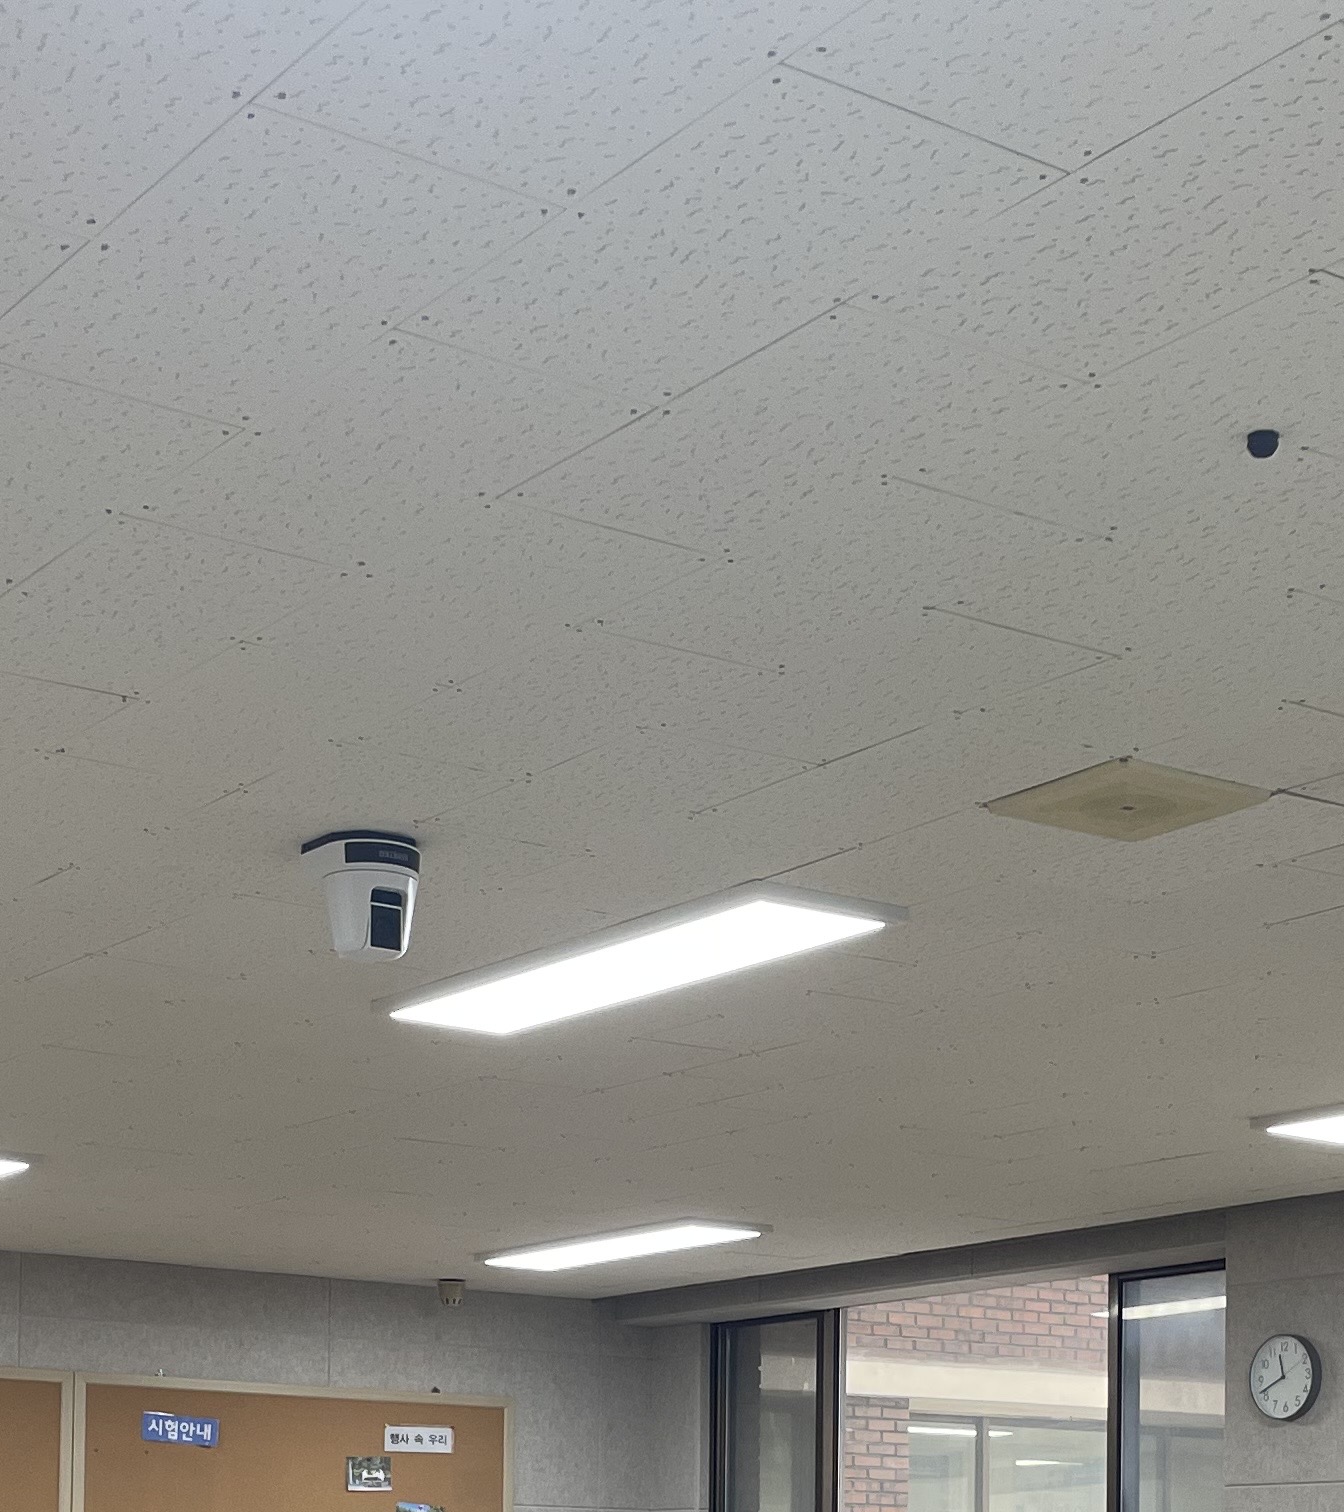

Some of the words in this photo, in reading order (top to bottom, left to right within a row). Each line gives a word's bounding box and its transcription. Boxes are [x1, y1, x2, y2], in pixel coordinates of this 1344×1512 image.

[1269, 1347, 1276, 1357] 11
[1281, 1341, 1289, 1352] 12
[1294, 1343, 1298, 1354] 1
[1302, 1353, 1308, 1364] 2
[1261, 1360, 1269, 1369] 10
[1305, 1368, 1311, 1380] 3
[1258, 1375, 1264, 1386] 9
[1303, 1385, 1308, 1393] 4
[1263, 1391, 1269, 1401] 8
[1295, 1396, 1301, 1407] 5
[1272, 1400, 1278, 1411] 7
[1283, 1401, 1289, 1412] 6
[147, 1419, 212, 1442] 시험안내
[389, 1433, 410, 1445] 행사
[428, 1433, 448, 1446] 우리
